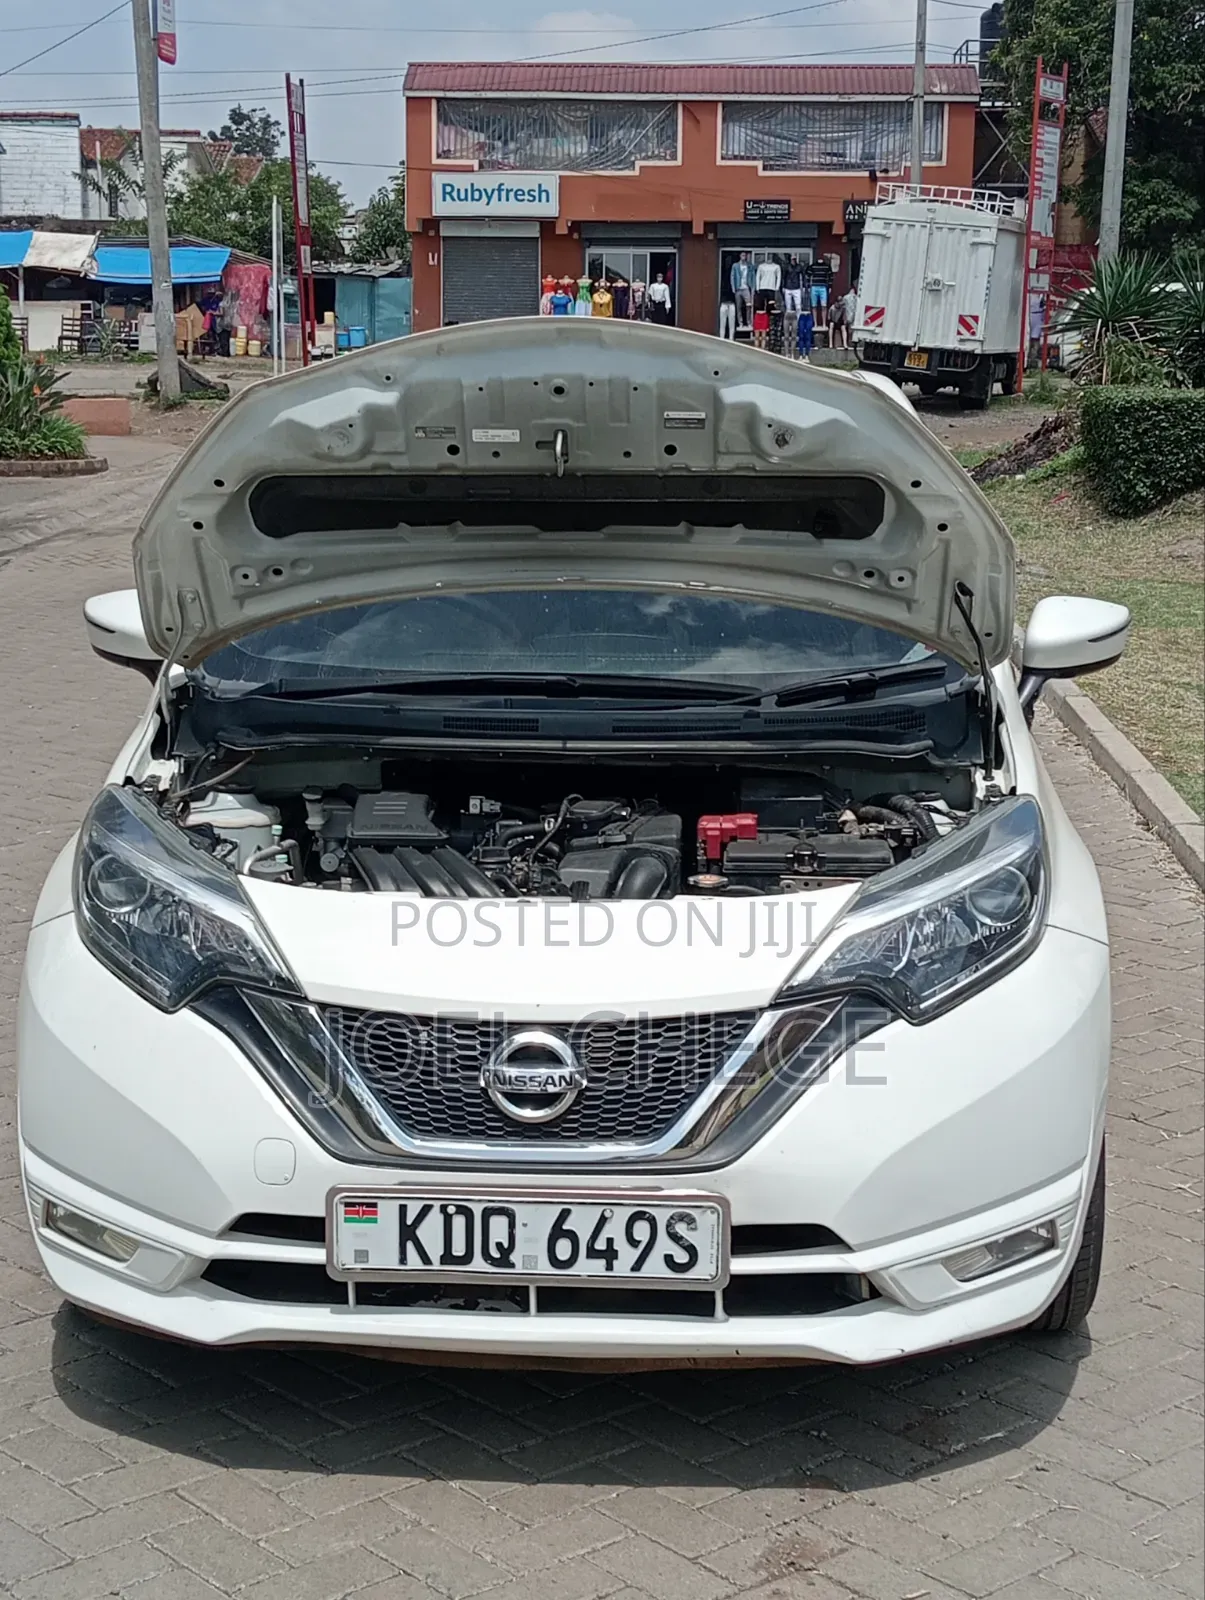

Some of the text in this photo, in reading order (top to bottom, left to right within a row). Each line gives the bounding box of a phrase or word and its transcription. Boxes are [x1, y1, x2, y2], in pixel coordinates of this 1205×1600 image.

[442, 182, 550, 205] Rubyfresh
[490, 1072, 574, 1090] NISSAN
[397, 1203, 517, 1269] KDQ
[546, 1207, 700, 1274] 649S
